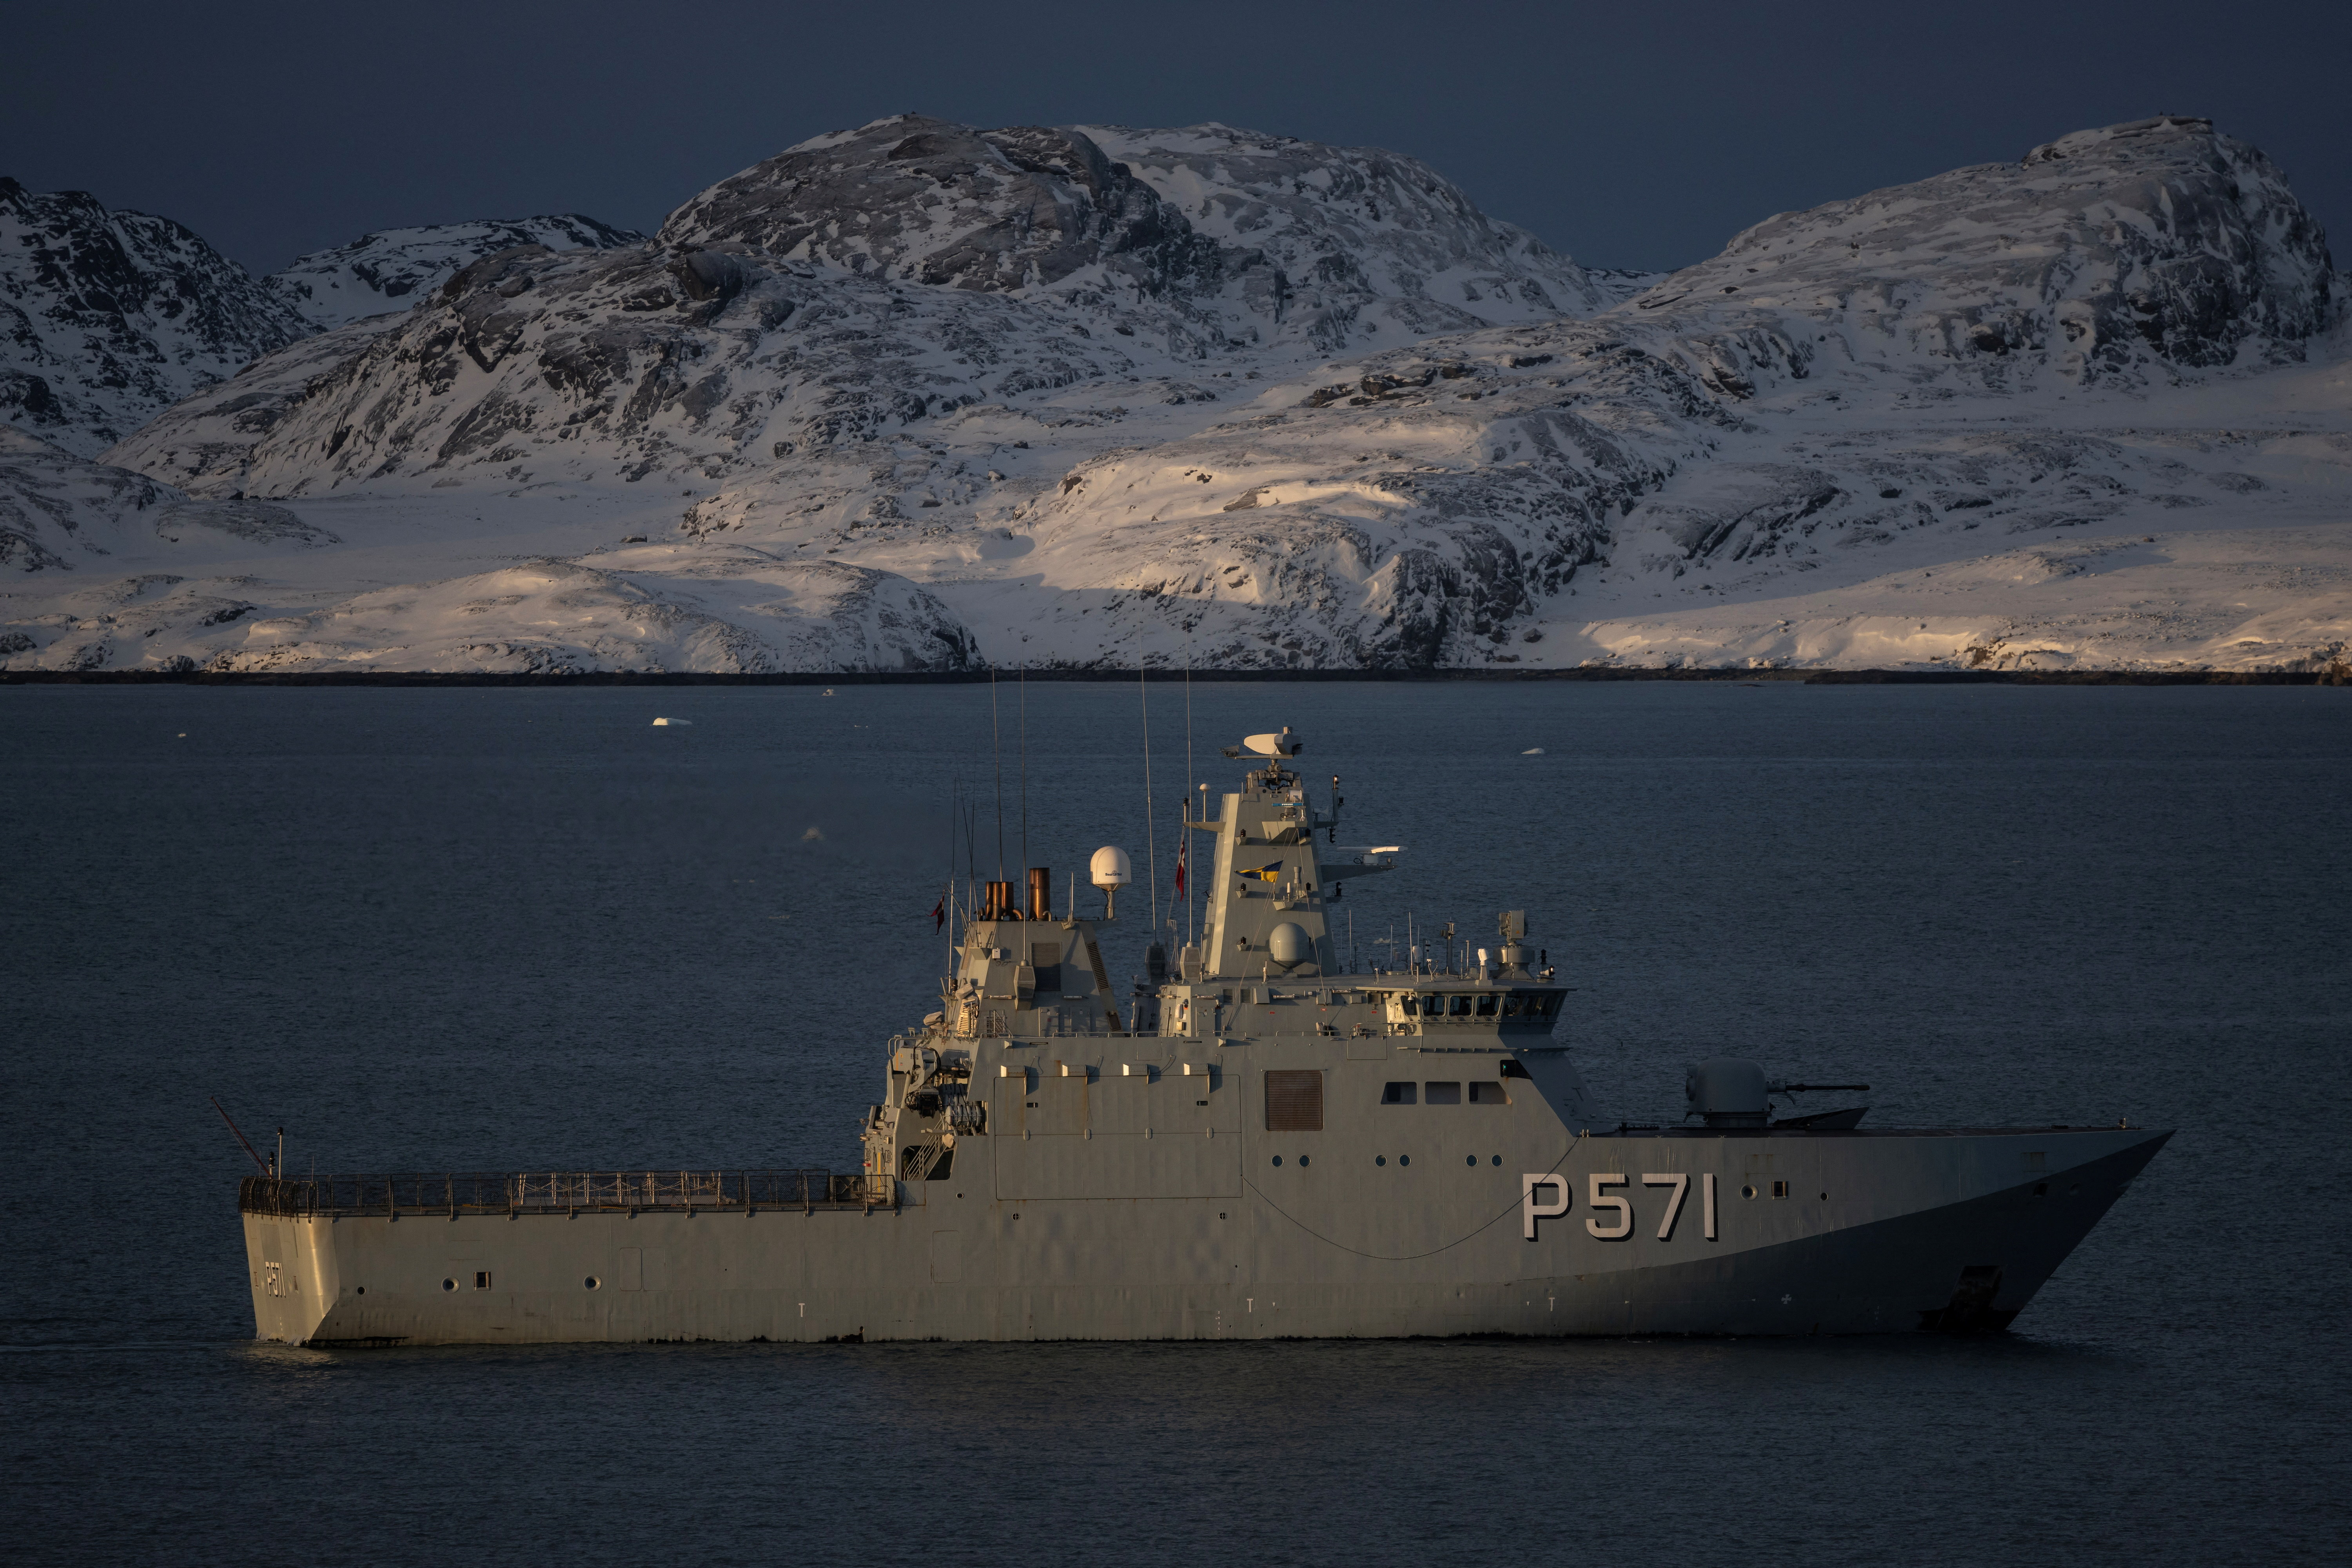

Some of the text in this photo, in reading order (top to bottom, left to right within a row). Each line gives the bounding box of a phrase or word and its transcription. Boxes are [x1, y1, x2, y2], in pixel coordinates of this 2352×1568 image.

[1523, 1174, 1719, 1242] P571
[265, 1261, 286, 1298] P571
[798, 1303, 805, 1318] T
[1247, 1299, 1253, 1313] T
[1549, 1297, 1555, 1311] T
